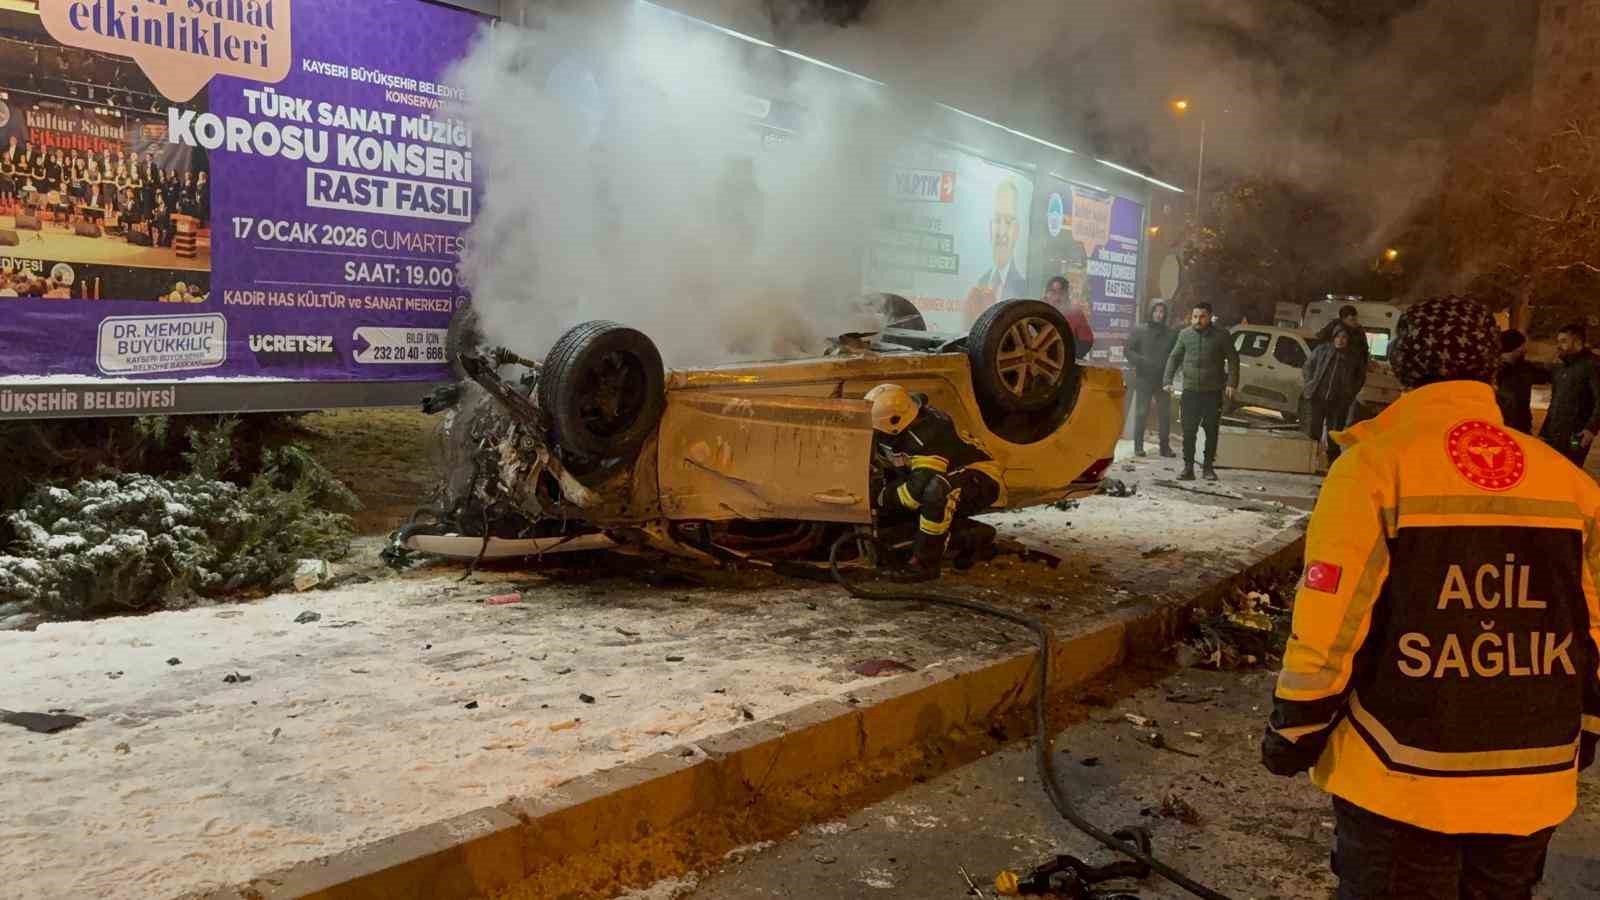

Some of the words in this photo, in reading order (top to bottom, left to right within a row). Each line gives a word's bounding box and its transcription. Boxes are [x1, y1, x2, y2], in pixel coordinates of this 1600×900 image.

[69, 0, 268, 68] etkinlikleri
[351, 66, 417, 92] BÜYÜKŞEHİR
[243, 87, 314, 123] TÜRK
[317, 102, 396, 135] SANAT
[385, 90, 448, 112] KONSERVAT
[167, 107, 329, 164] KOROSU
[337, 133, 473, 183] KONSERİ
[313, 171, 389, 208] RAST
[396, 182, 470, 218] FASLI
[231, 216, 254, 239] 17
[257, 219, 318, 245] OCAK
[321, 224, 368, 248] 2026
[371, 228, 466, 256] CUMARTES
[344, 261, 401, 284] SAAT:
[405, 265, 453, 287] 19.00
[224, 289, 266, 306] KADİR
[268, 291, 295, 307] HAS
[297, 290, 345, 309] KÜLTÜR
[348, 298, 362, 309] ve
[364, 296, 404, 310] SANAT
[114, 323, 141, 339] DR.
[145, 320, 216, 337] MEMDUH
[373, 346, 393, 360] 232
[394, 346, 406, 361] 20
[407, 346, 419, 361] 40
[83, 385, 176, 410] BELEDİYESİ
[1436, 552, 1548, 610] ACİL
[1397, 619, 1577, 678] SAĞLIK
